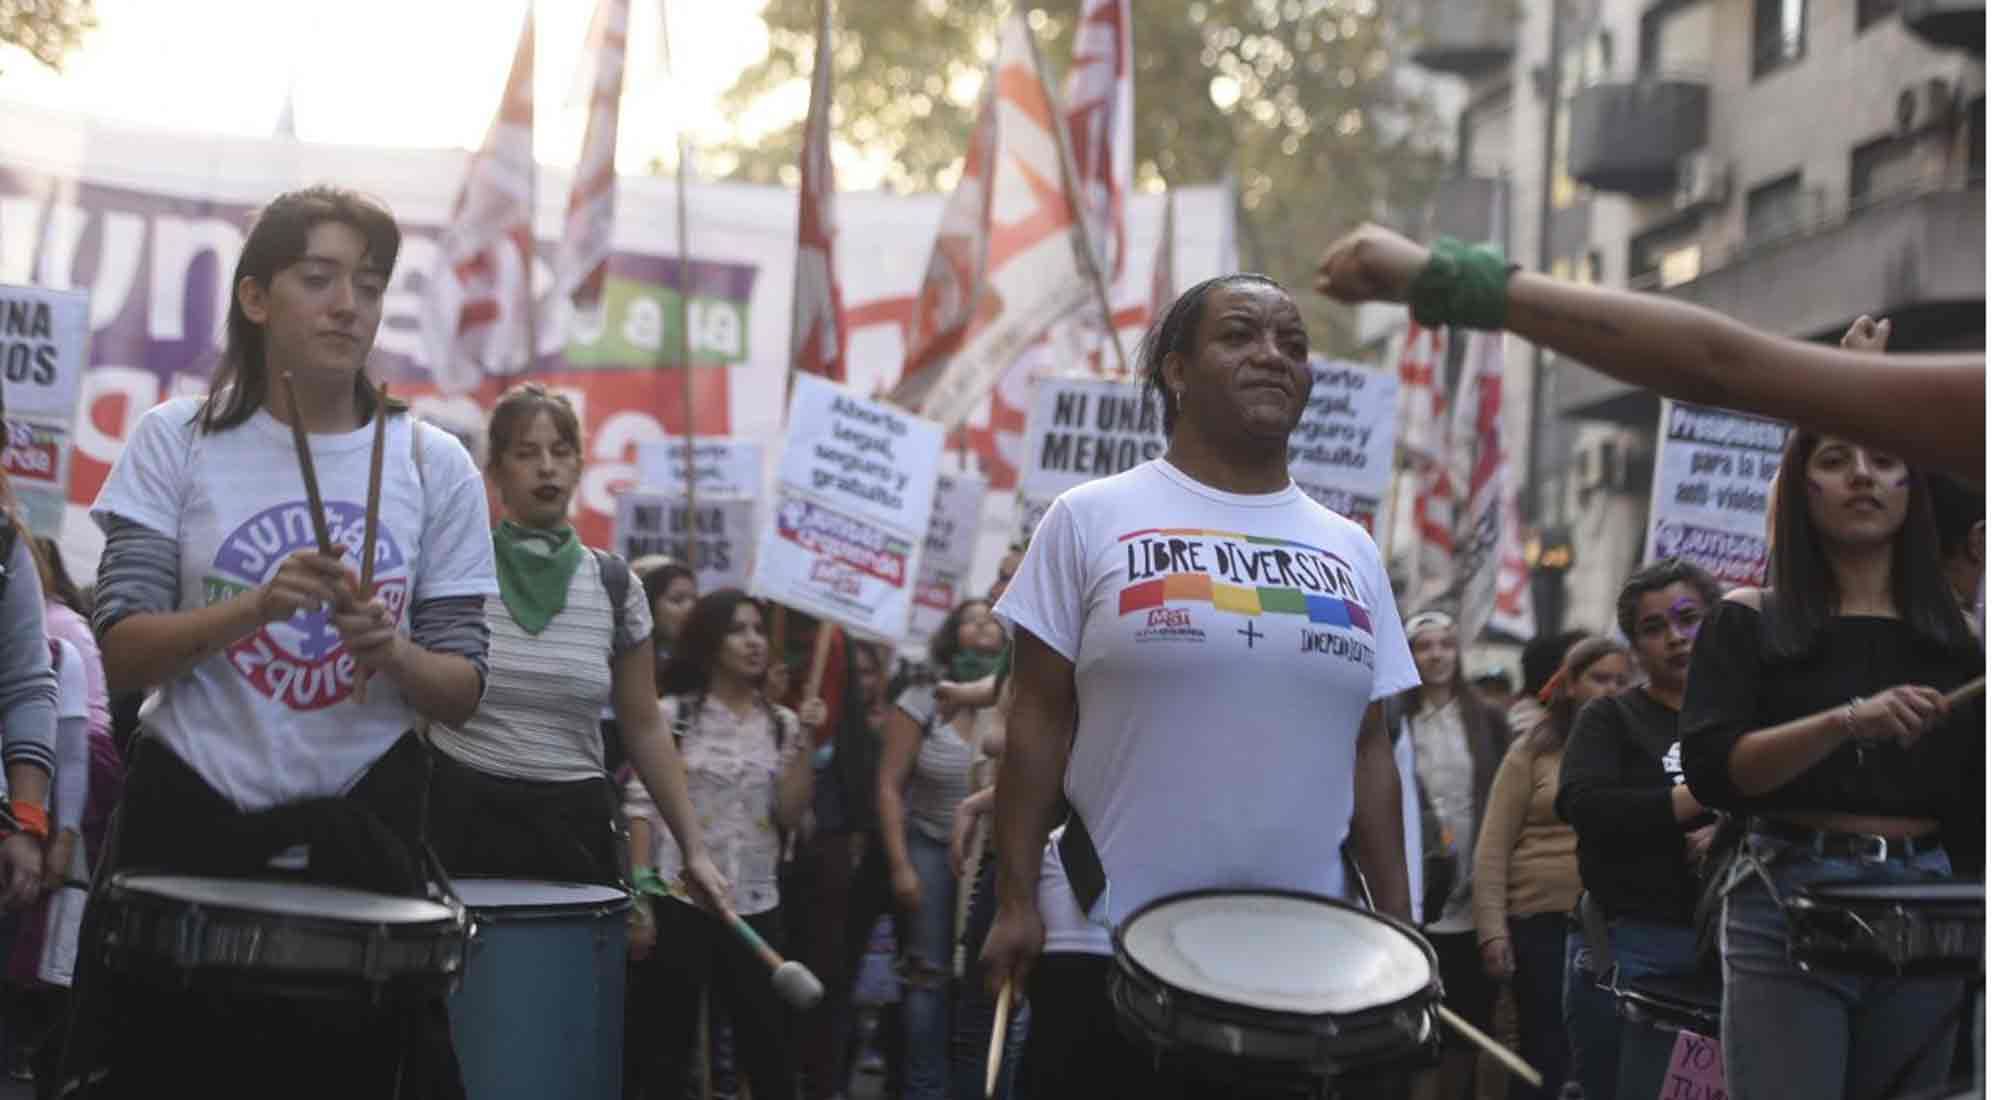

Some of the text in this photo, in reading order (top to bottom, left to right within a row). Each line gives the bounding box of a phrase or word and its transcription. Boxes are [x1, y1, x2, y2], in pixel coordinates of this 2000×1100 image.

[1053, 387, 1158, 433] NI UNA
[1738, 454, 1754, 477] la
[1127, 538, 1208, 582] LIBRE
